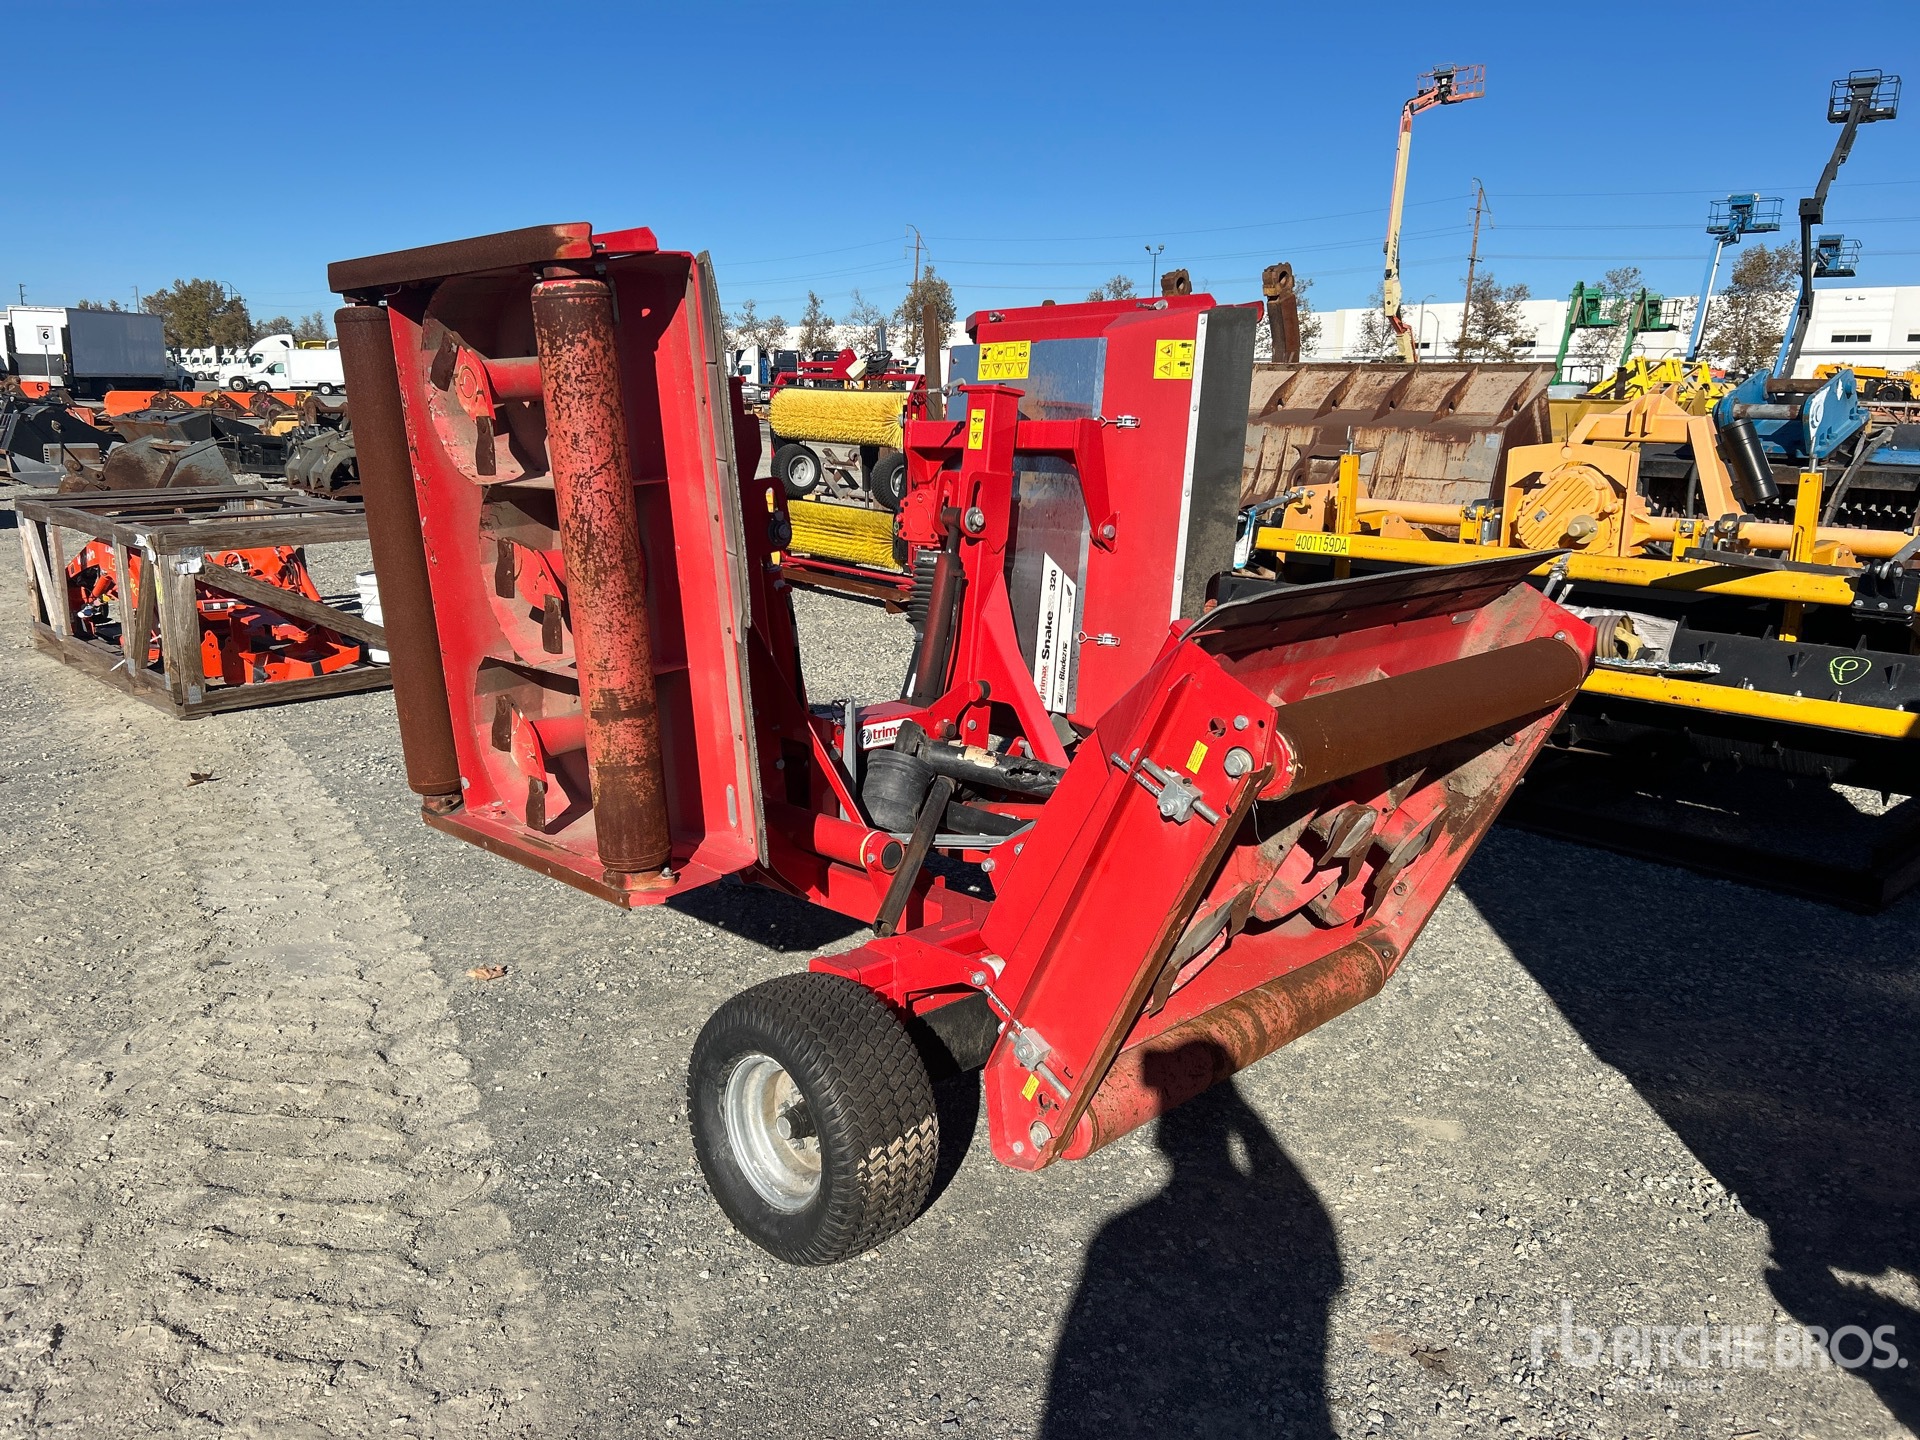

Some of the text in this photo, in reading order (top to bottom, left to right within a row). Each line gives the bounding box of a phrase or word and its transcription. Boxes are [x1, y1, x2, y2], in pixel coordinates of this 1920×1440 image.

[42, 331, 49, 339] 6
[36, 382, 44, 391] 6
[1296, 534, 1347, 553] 4001159DA
[1049, 569, 1057, 592] 320
[1041, 611, 1053, 660] Snake
[1039, 665, 1048, 695] trimax
